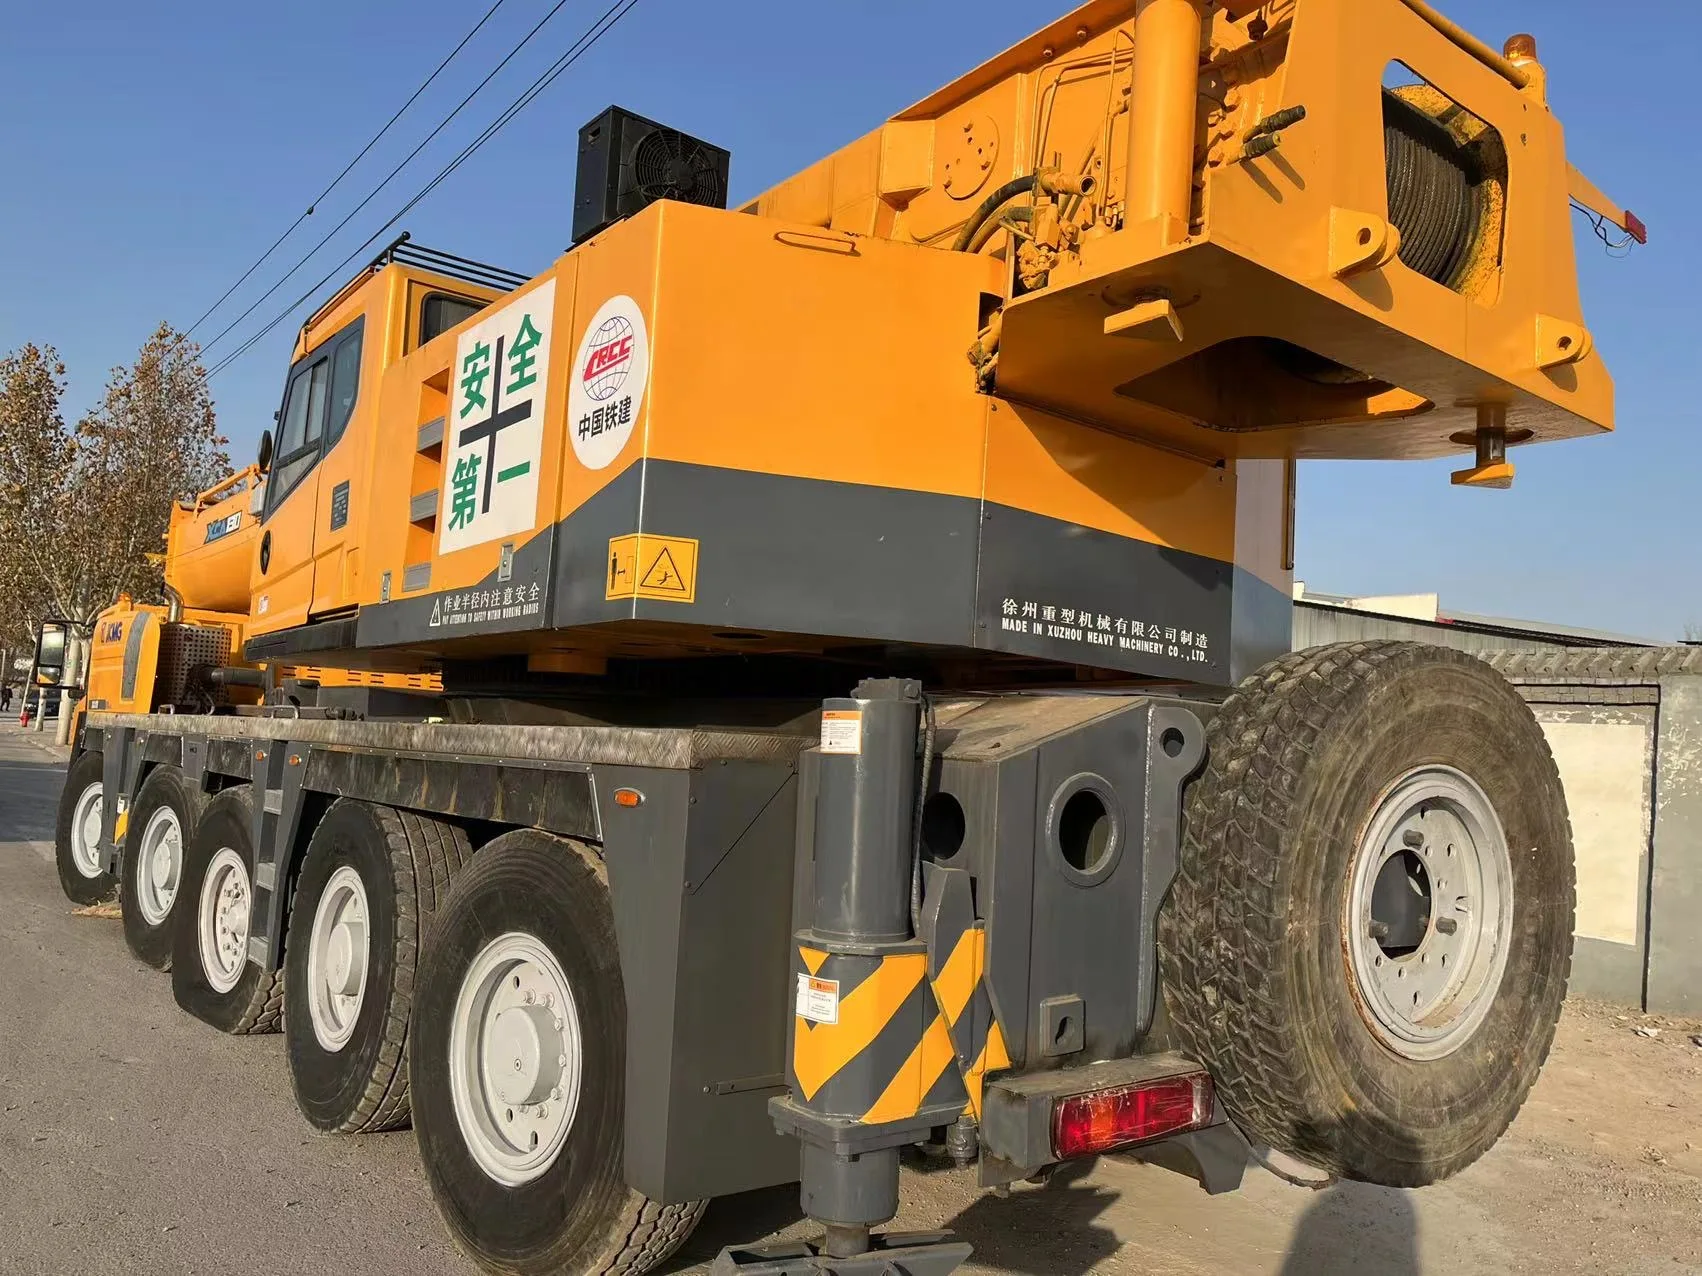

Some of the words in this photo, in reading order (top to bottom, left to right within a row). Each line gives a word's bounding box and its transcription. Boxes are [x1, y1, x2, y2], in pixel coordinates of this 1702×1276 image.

[583, 334, 633, 382] CRCC
[578, 395, 632, 441] 中国铁建
[444, 582, 539, 612] 作业半径内注意安全
[1001, 617, 1028, 633] MADE
[1033, 622, 1043, 635] IN
[1047, 624, 1082, 642] XUZHOU
[1087, 631, 1114, 647] HEAVY
[1119, 637, 1163, 654] MACHINERY
[1002, 598, 1208, 649] 徐州重型机械有限公司制造
